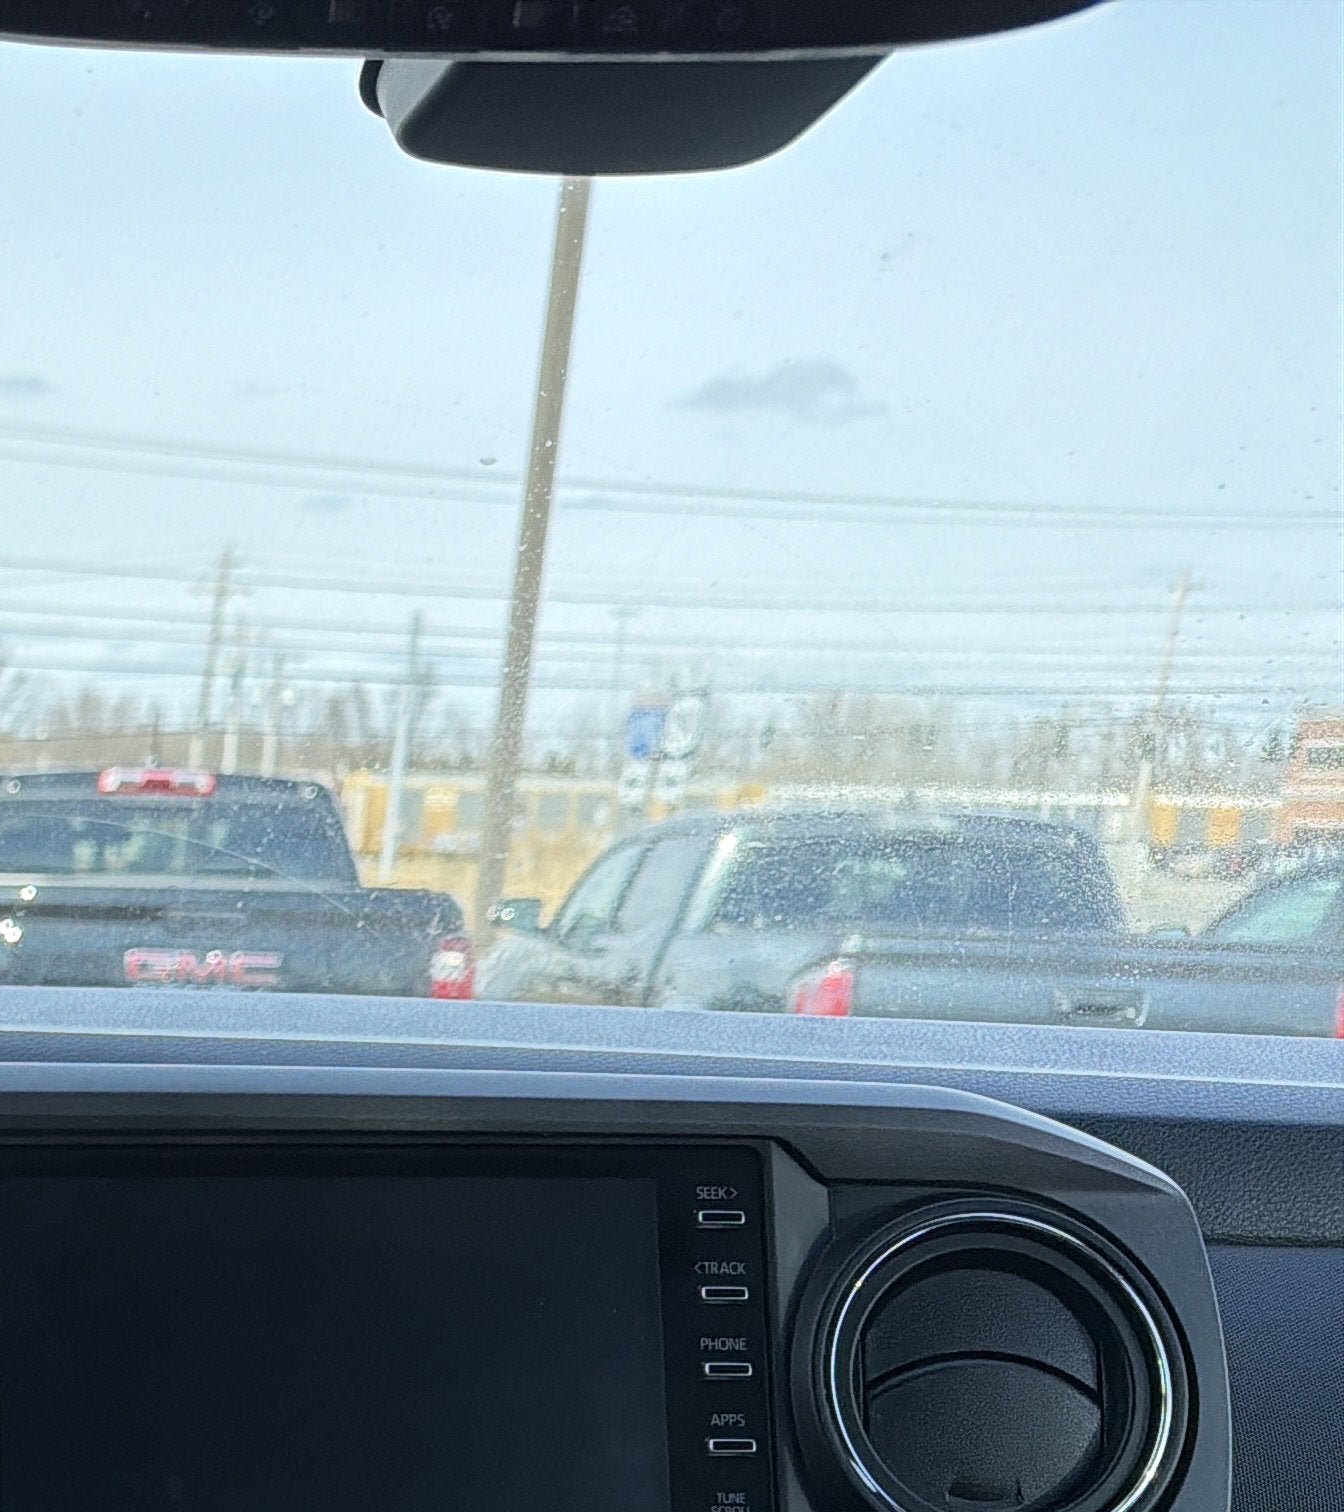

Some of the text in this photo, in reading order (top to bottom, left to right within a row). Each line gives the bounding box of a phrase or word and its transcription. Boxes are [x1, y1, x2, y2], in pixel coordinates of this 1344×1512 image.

[124, 948, 284, 986] GMC
[700, 1337, 748, 1351] PHONE
[710, 1413, 746, 1427] APPS
[716, 1492, 746, 1504] TUNE
